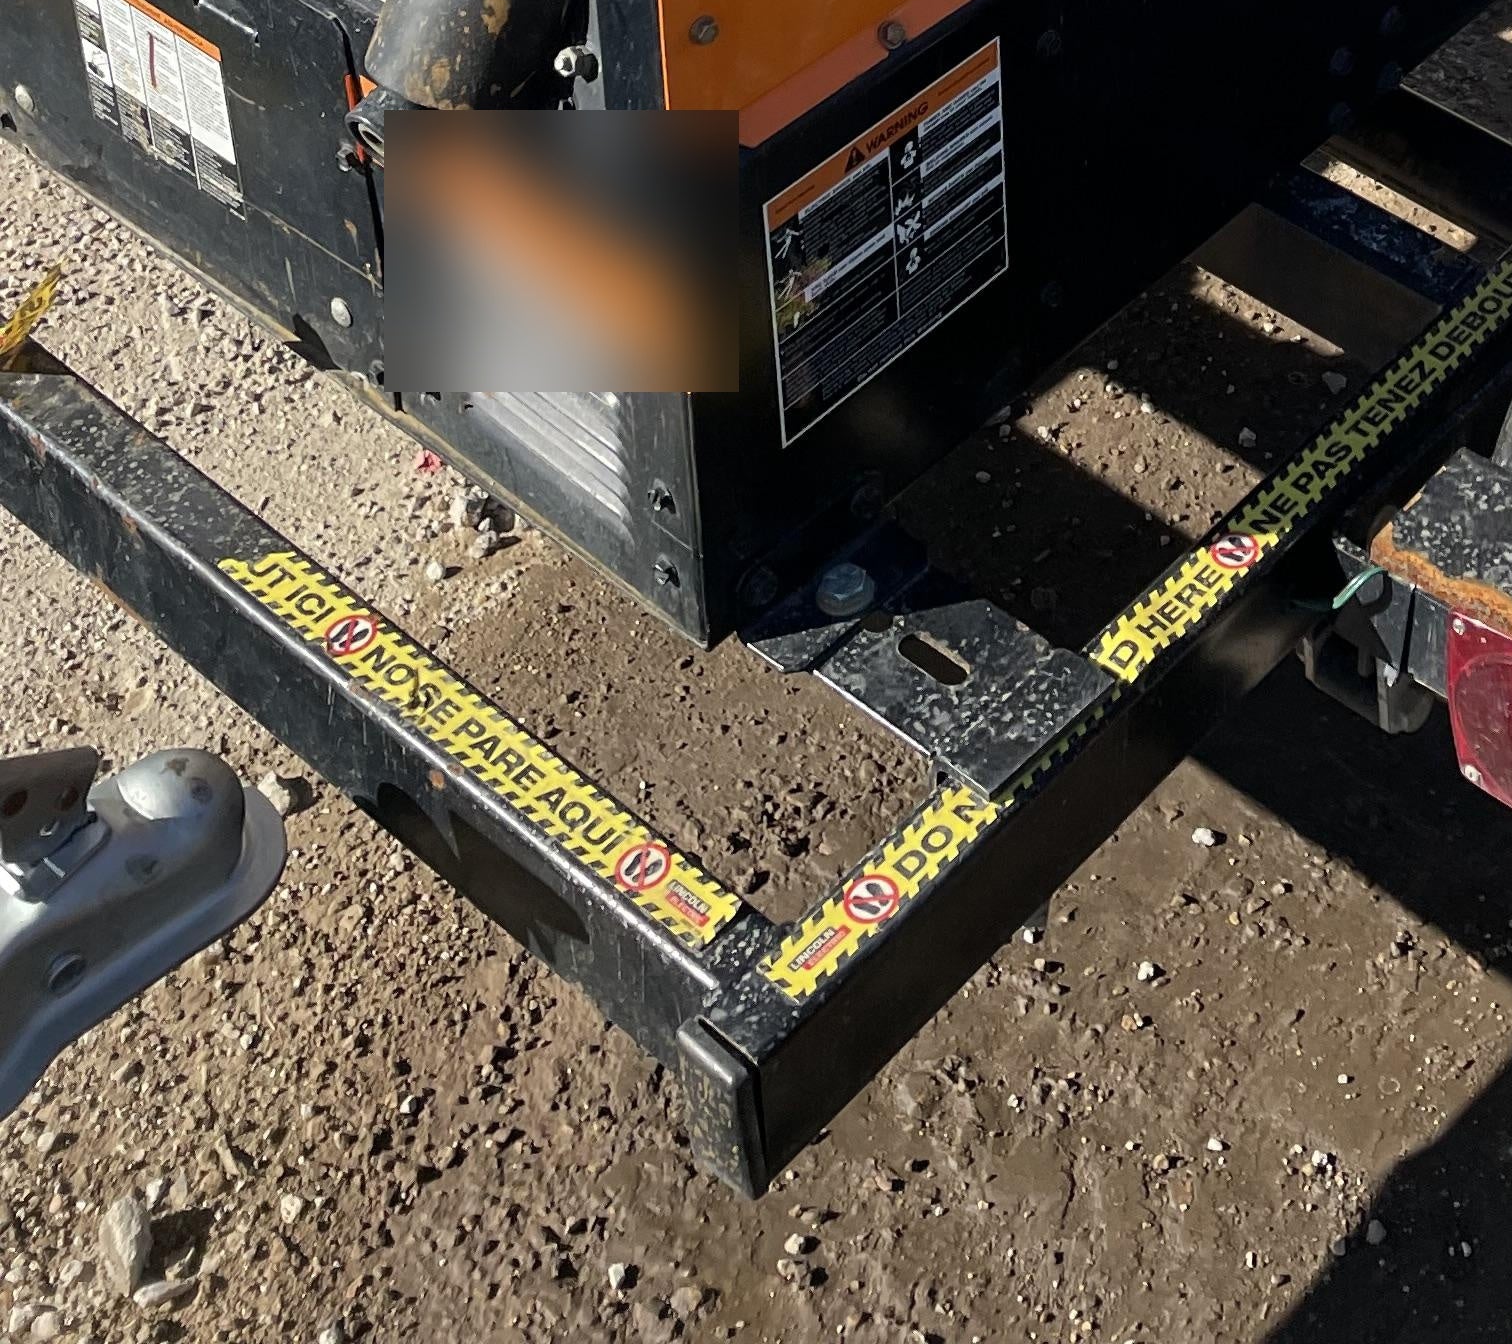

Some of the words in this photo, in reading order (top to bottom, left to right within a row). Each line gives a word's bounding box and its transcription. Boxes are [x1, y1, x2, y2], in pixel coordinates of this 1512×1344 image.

[865, 101, 930, 155] WARNING
[1249, 493, 1299, 534] NE
[1291, 441, 1353, 495] PAS
[1343, 359, 1438, 439] TENEZ
[284, 583, 337, 625] ICI
[1135, 564, 1225, 641] HERE
[360, 644, 417, 687] NO
[415, 680, 464, 727] SE
[451, 716, 547, 793] PARE
[892, 824, 955, 881] DO
[667, 879, 710, 914] LINCOLN
[790, 927, 836, 971] LINCOLN
